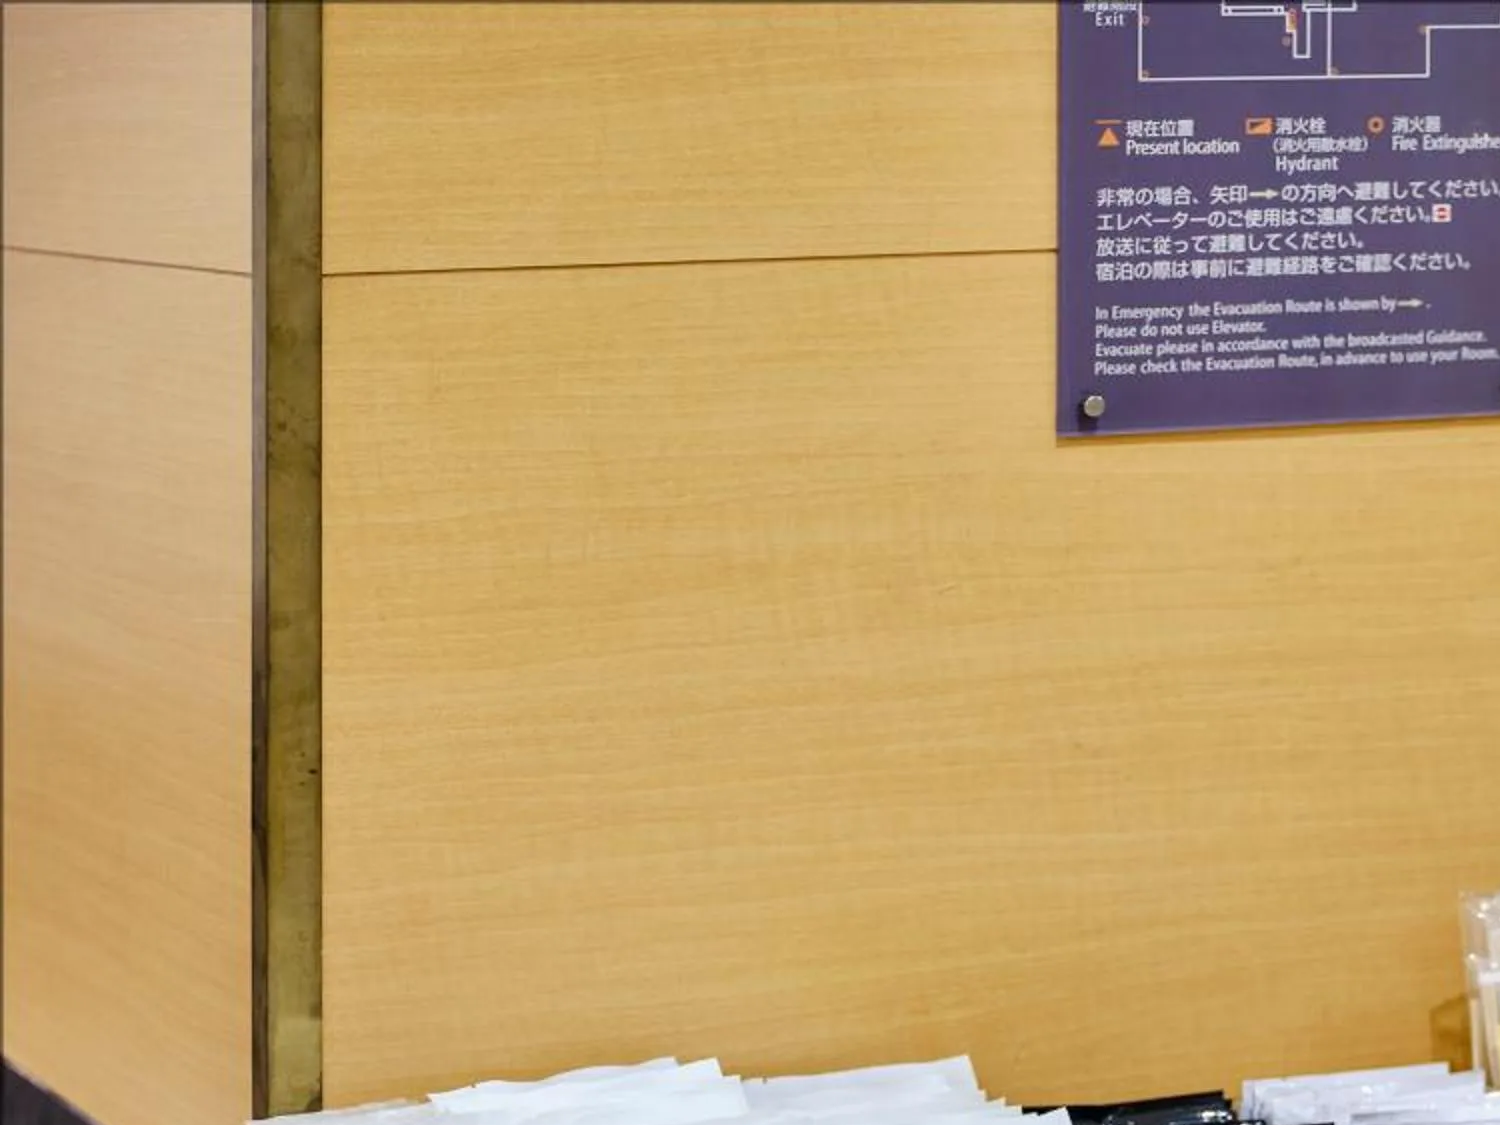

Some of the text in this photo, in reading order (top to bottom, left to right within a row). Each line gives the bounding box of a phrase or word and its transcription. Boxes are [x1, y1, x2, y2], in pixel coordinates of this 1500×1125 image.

[1095, 12, 1125, 26] Exit
[1125, 119, 1194, 137] 現在位置
[1276, 117, 1326, 134] 消火栓
[1391, 115, 1441, 133] 消火器
[1125, 138, 1240, 155] Present location
[1392, 136, 1418, 150] Fire
[1275, 156, 1338, 175] Hydrant
[1095, 296, 1396, 321] In Emergency the Evacuation Route is shown by
[1095, 320, 1267, 339] Please do not use Elevator.
[1095, 329, 1488, 357] Evacuate please in accordance with the broadcasted Guidance.
[1094, 346, 1500, 376] Please check the Evacuation Route, in advance to use your Room.
